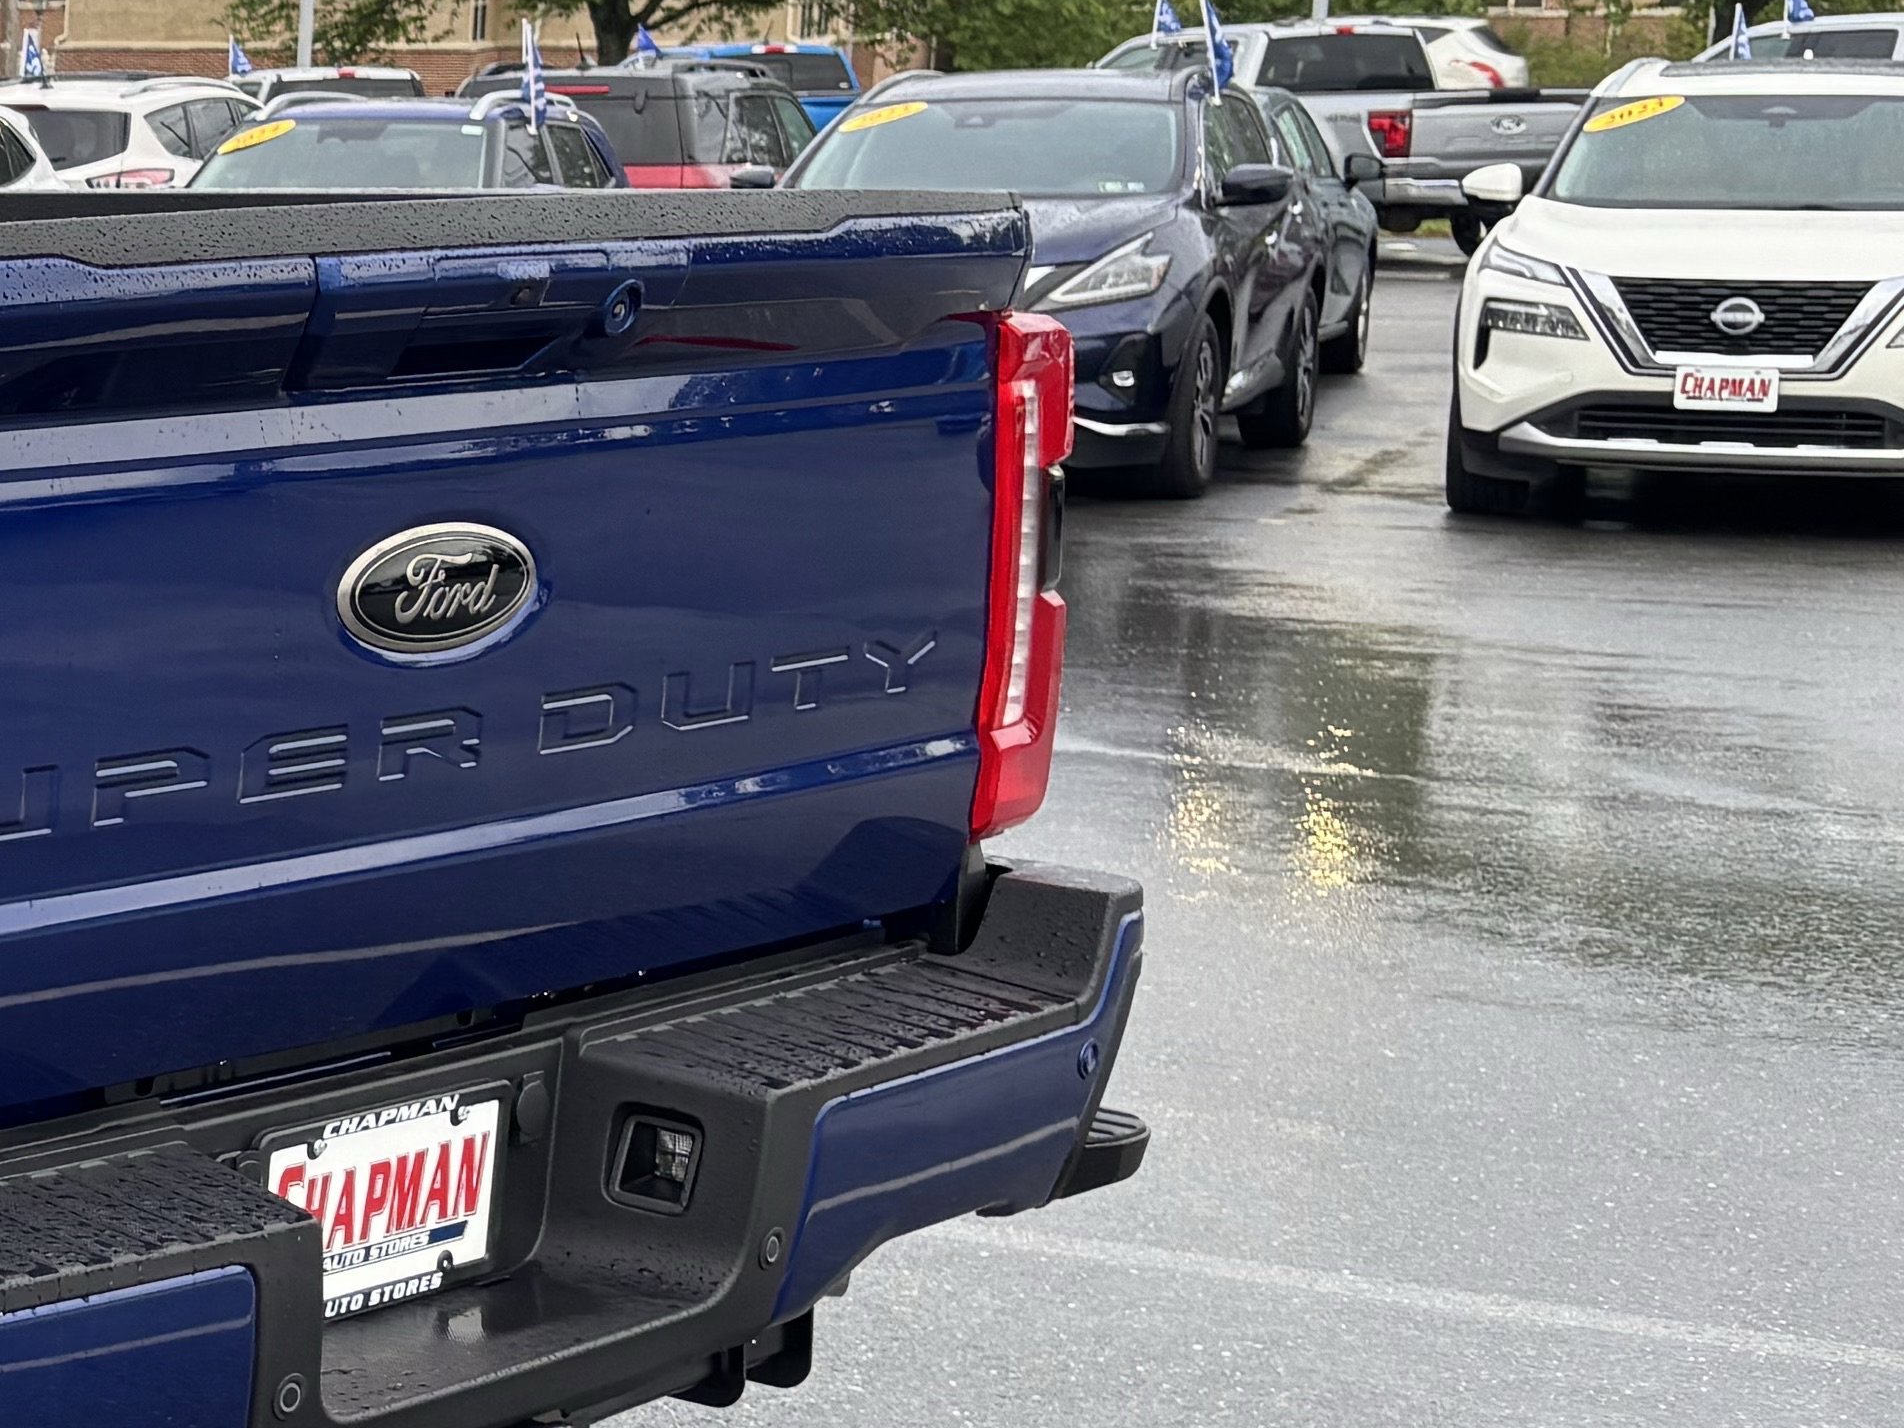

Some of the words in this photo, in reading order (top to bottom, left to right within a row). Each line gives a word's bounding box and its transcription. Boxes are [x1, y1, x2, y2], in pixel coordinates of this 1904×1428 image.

[1680, 372, 1771, 398] CHAPMAN
[395, 552, 500, 624] Ford
[538, 630, 937, 756] DUTY
[322, 1093, 460, 1139] CHAPMAN
[368, 1233, 431, 1261] STORES
[324, 1293, 364, 1318] UTO
[368, 1271, 444, 1306] STORES
